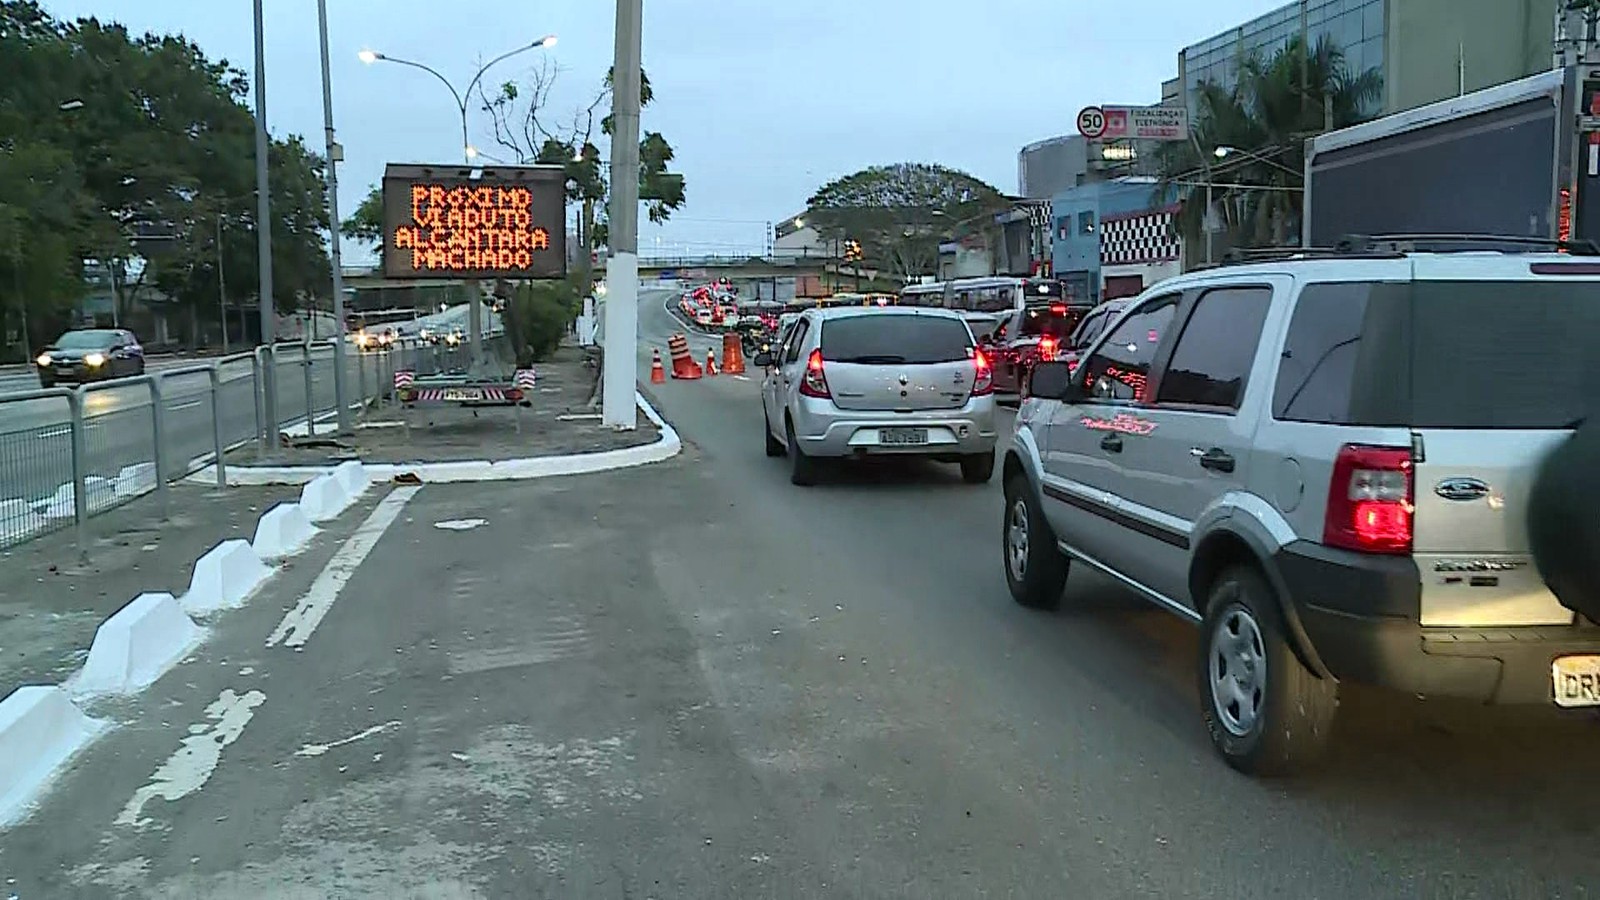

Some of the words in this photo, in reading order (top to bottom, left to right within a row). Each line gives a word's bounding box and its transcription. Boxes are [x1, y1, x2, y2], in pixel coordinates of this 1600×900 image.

[1082, 113, 1103, 129] 50
[412, 206, 532, 228] VIADUTO
[412, 249, 532, 270] MACHADO
